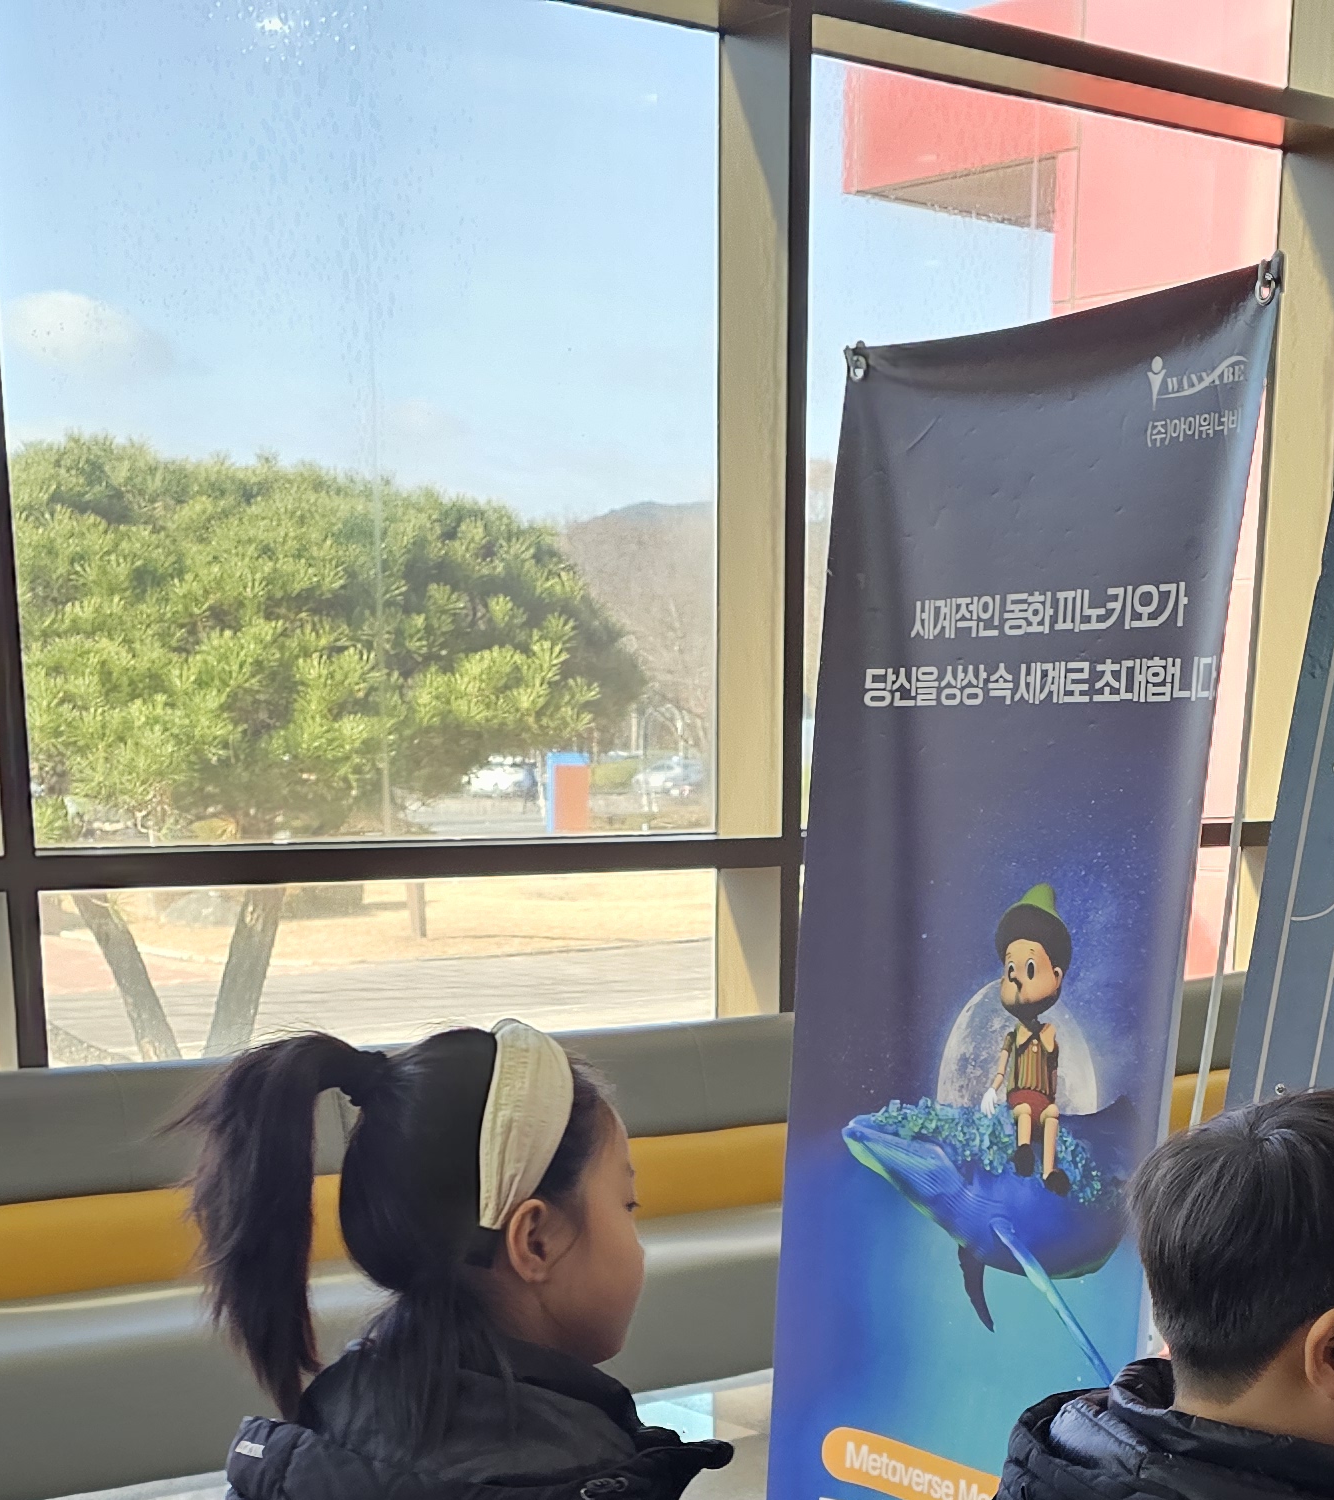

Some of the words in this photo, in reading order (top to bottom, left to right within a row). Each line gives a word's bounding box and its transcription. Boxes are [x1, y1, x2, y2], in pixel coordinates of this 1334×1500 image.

[1147, 408, 1242, 448] (주)아이워너비
[910, 595, 1000, 640] 세계적인
[1002, 590, 1053, 635] 동화
[1054, 582, 1188, 632] 피노키오가
[863, 665, 938, 708] 당신을
[939, 664, 987, 707] 상상
[988, 663, 1013, 706] 속
[1014, 660, 1090, 706] 세계로
[1094, 655, 1216, 703] 초대합니다
